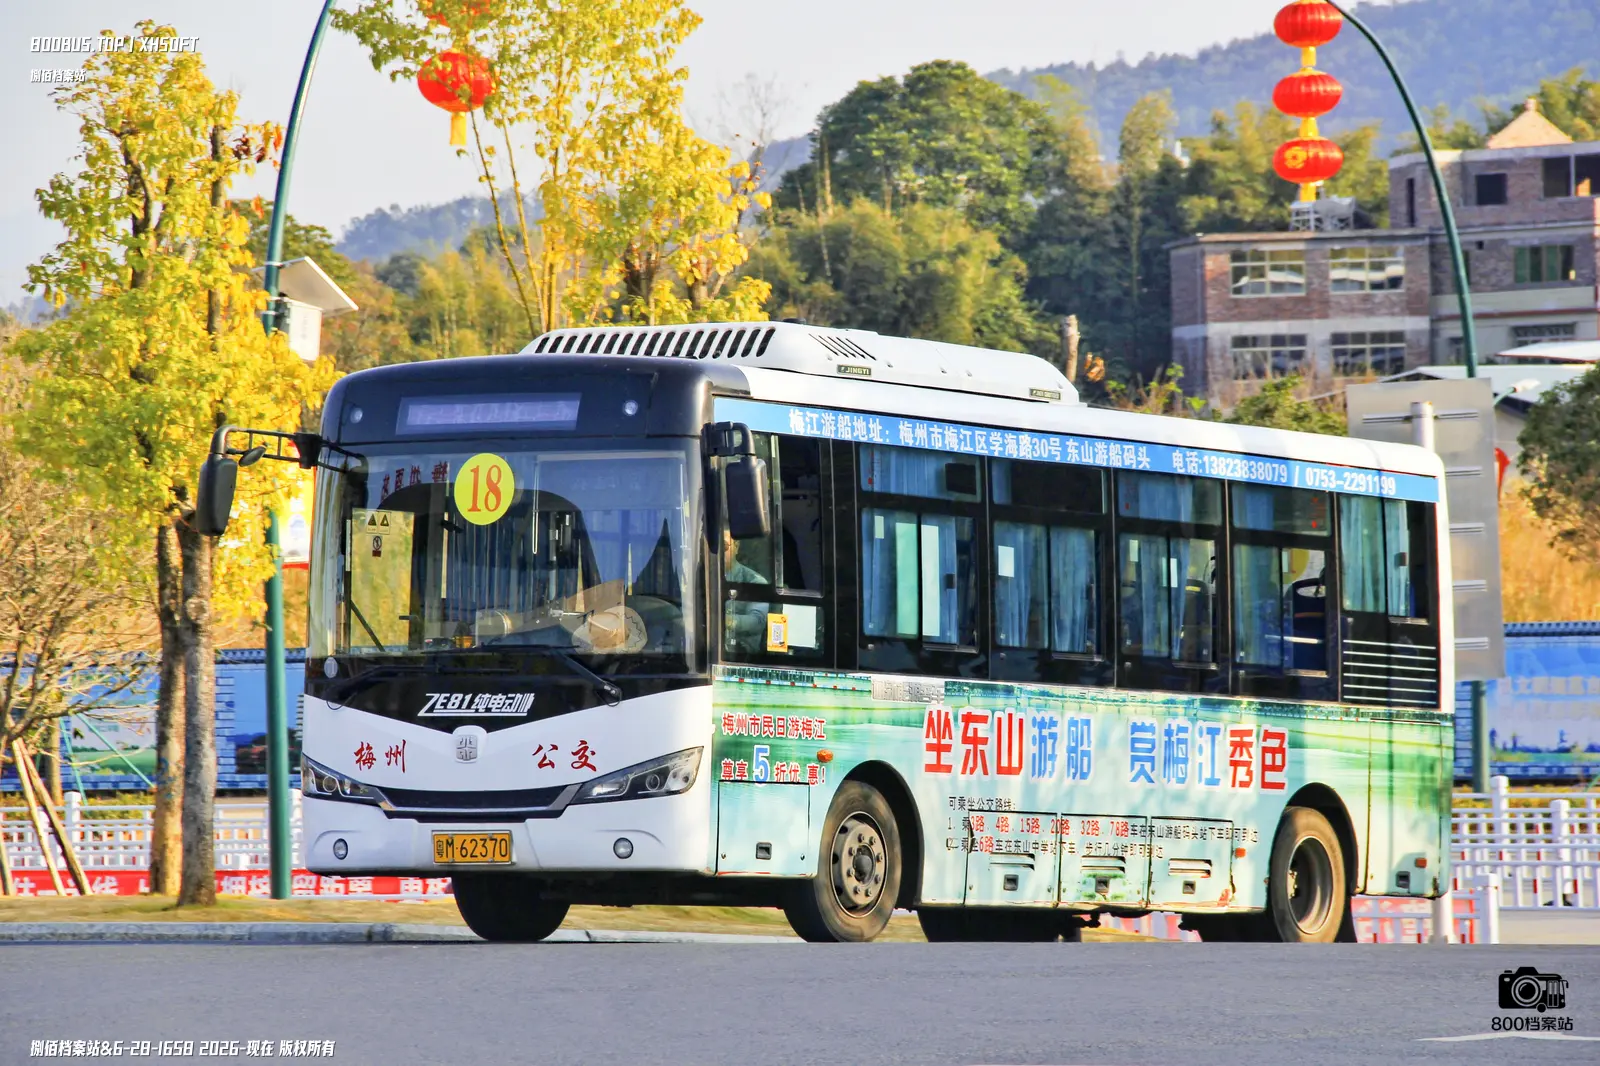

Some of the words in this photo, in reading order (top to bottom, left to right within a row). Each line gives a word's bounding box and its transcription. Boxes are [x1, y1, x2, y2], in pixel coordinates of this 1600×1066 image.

[788, 408, 1063, 463] 梅江游船地址：梅州市梅江区学海路30号
[1065, 438, 1151, 470] 东山游船码头
[1172, 450, 1288, 483] 电话:13823838079
[1305, 467, 1397, 496] 0753-2291199
[467, 465, 502, 512] 18
[722, 713, 826, 740] 梅州市民日游梅江
[925, 709, 1092, 780] 坐东山游船
[1129, 721, 1287, 790] 赏梅江秀色
[354, 740, 406, 773] 梅州
[532, 740, 597, 772] 公交
